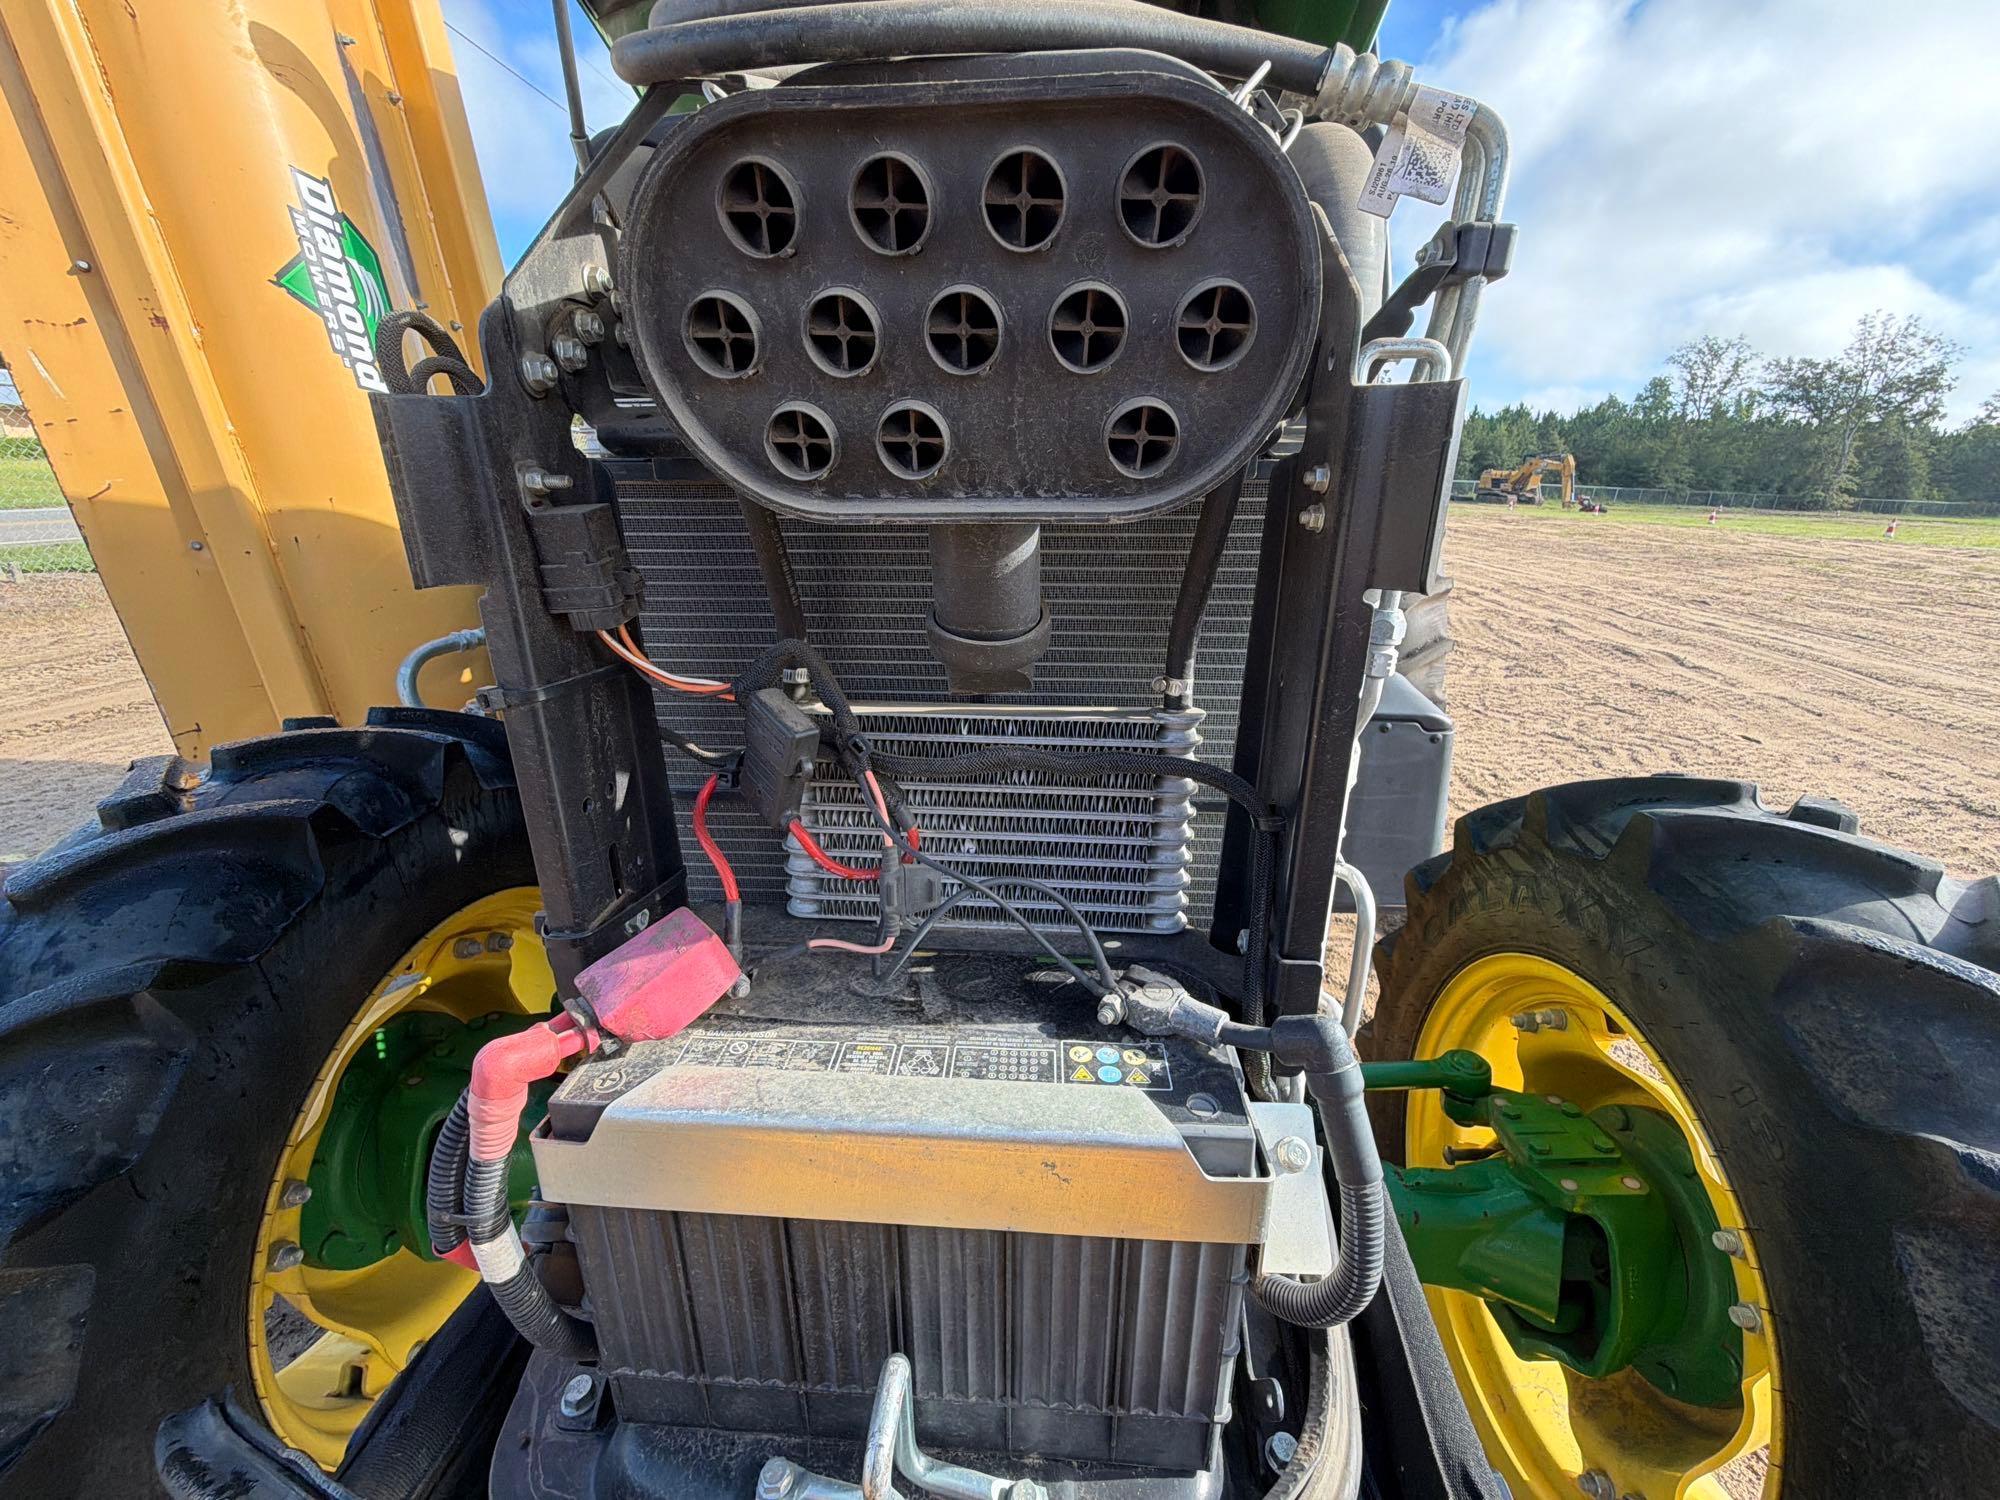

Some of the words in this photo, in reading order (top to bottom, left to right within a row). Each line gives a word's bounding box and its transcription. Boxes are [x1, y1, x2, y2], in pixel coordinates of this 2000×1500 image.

[1451, 114, 1465, 131] LTD
[292, 211, 347, 352] MOWERS
[295, 172, 391, 395] Diamond
